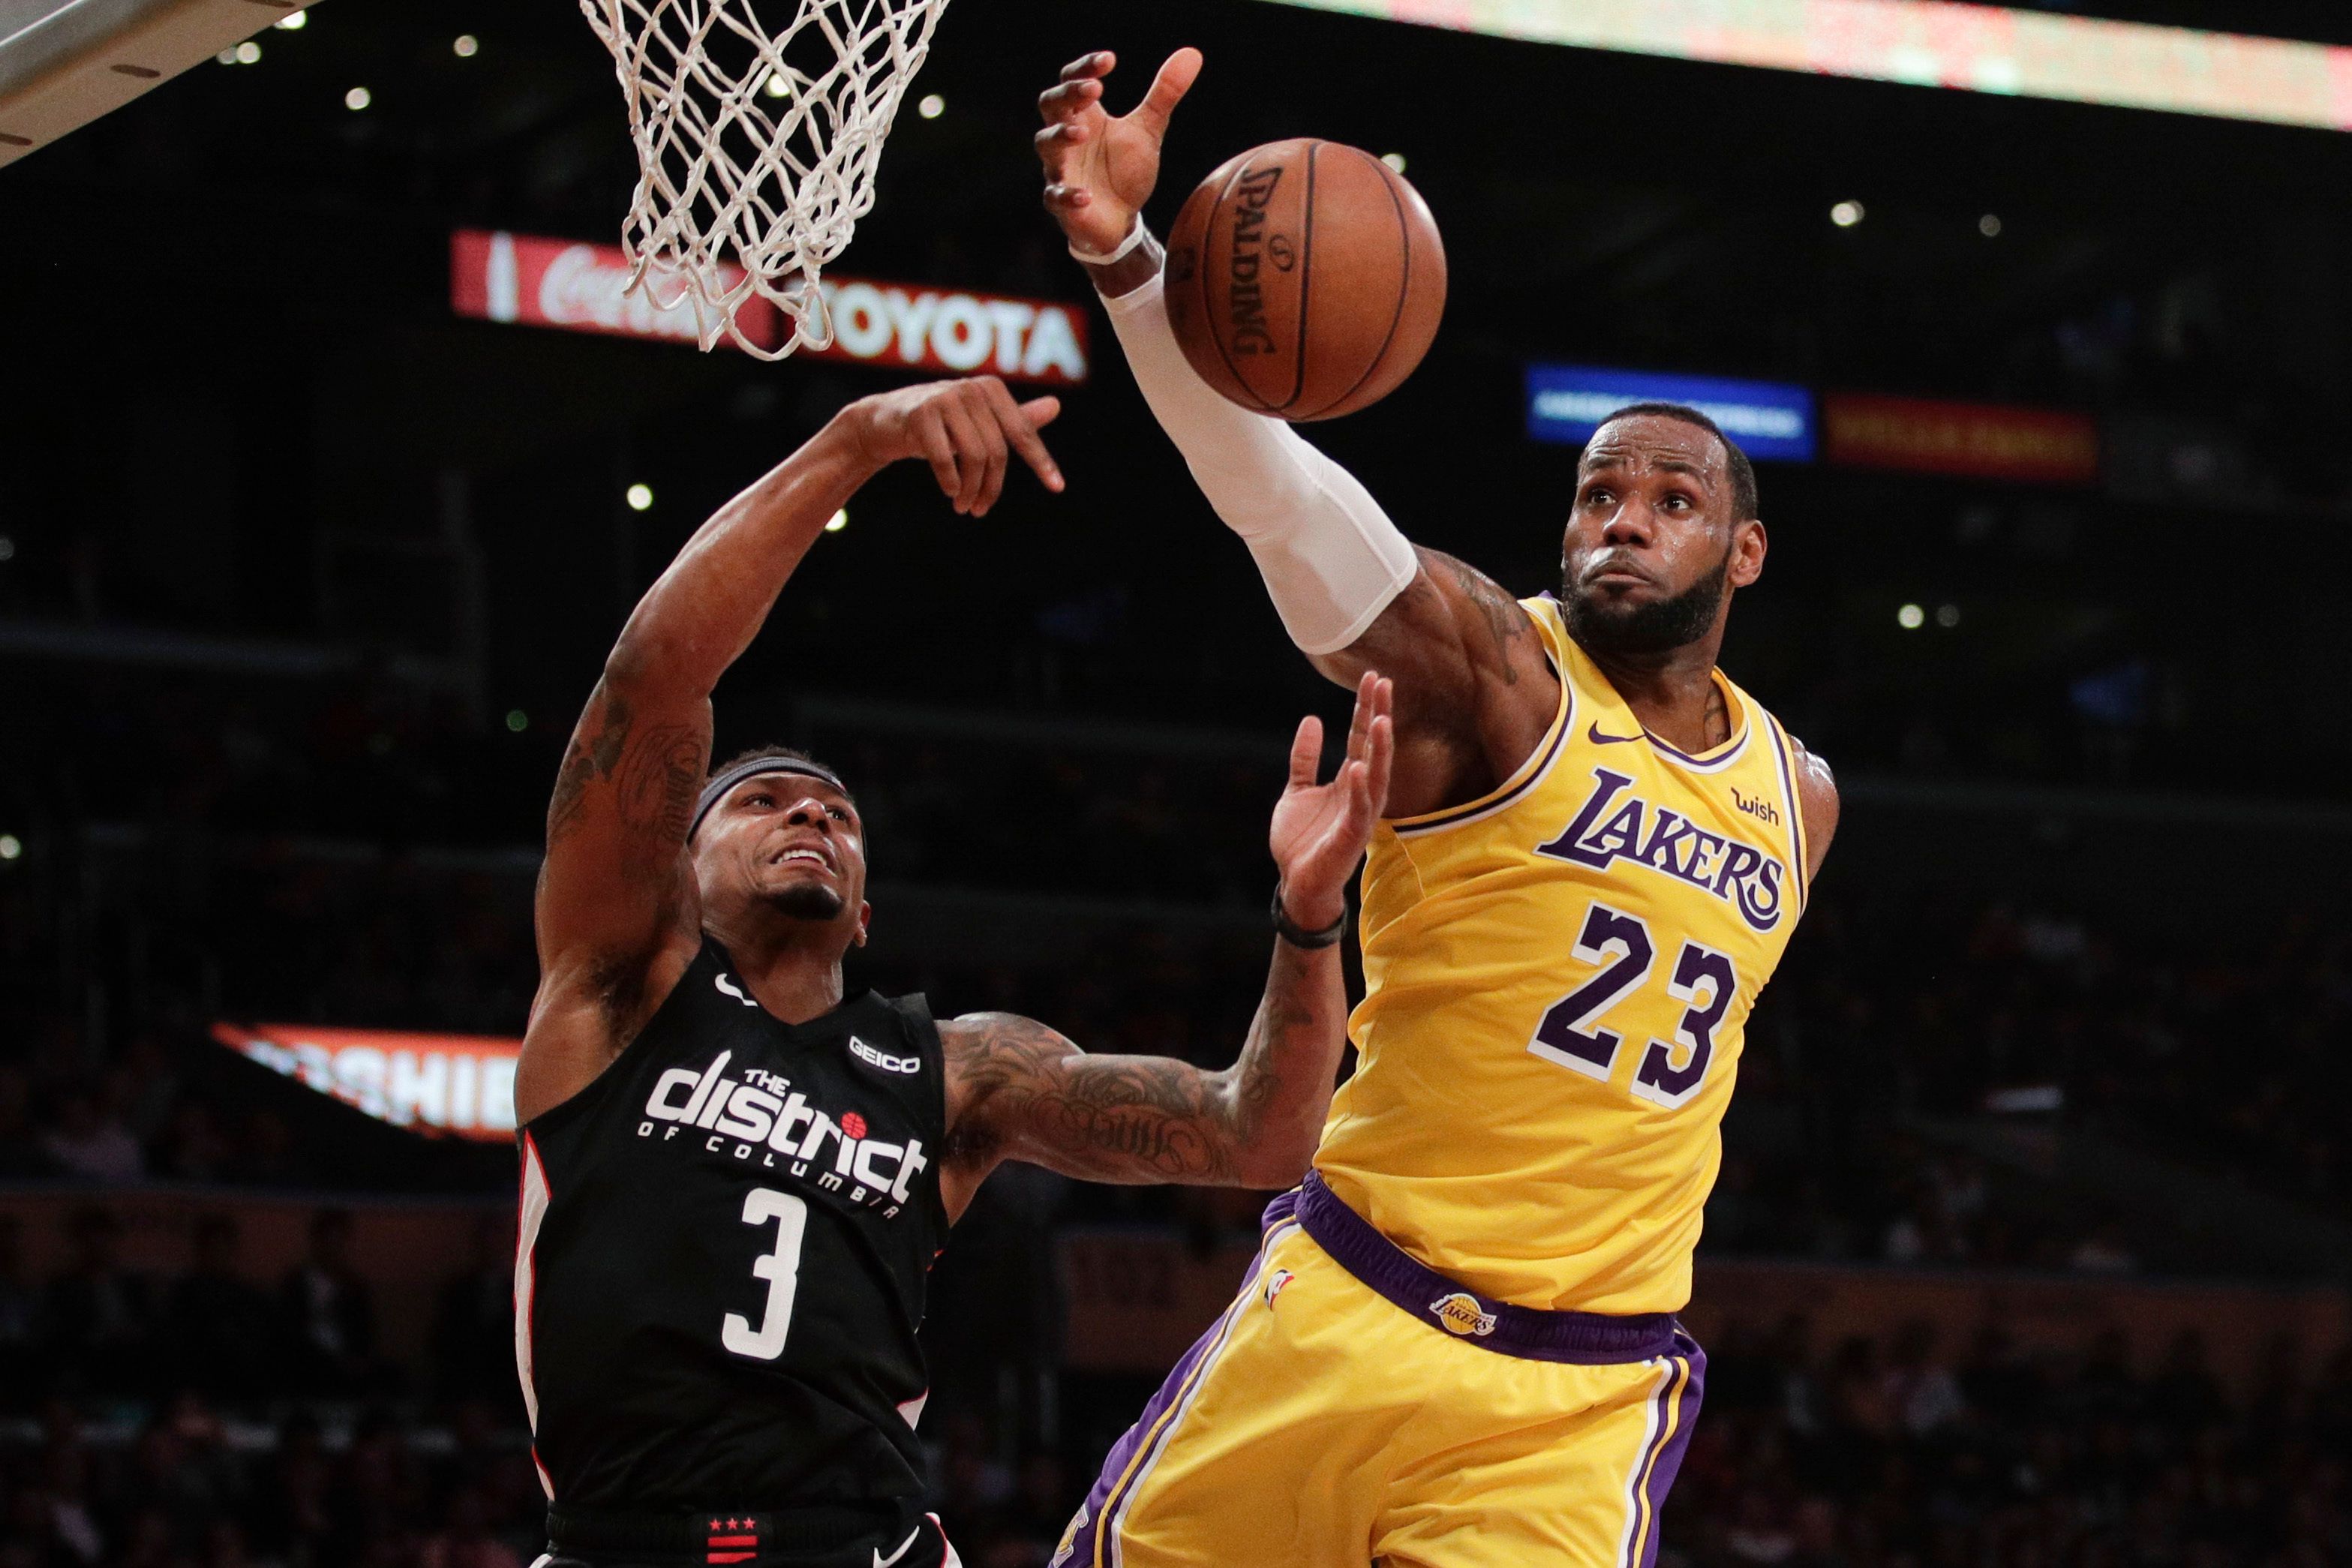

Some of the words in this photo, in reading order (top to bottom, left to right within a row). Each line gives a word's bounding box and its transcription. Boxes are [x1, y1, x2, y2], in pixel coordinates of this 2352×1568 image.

[1230, 166, 1283, 356] SPALDING
[784, 278, 1087, 380] TOYOTA
[1533, 765, 1787, 934] LAKERS
[1731, 788, 1780, 827] wish
[849, 1035, 921, 1074] GEICO
[1526, 900, 1737, 1110] 23
[645, 1049, 928, 1204] district
[743, 1068, 791, 1098] THE
[637, 1122, 680, 1141] OF
[706, 1136, 900, 1219] COLUMBIA
[721, 1187, 807, 1360] 3
[1432, 1296, 1494, 1335] LAKERS
